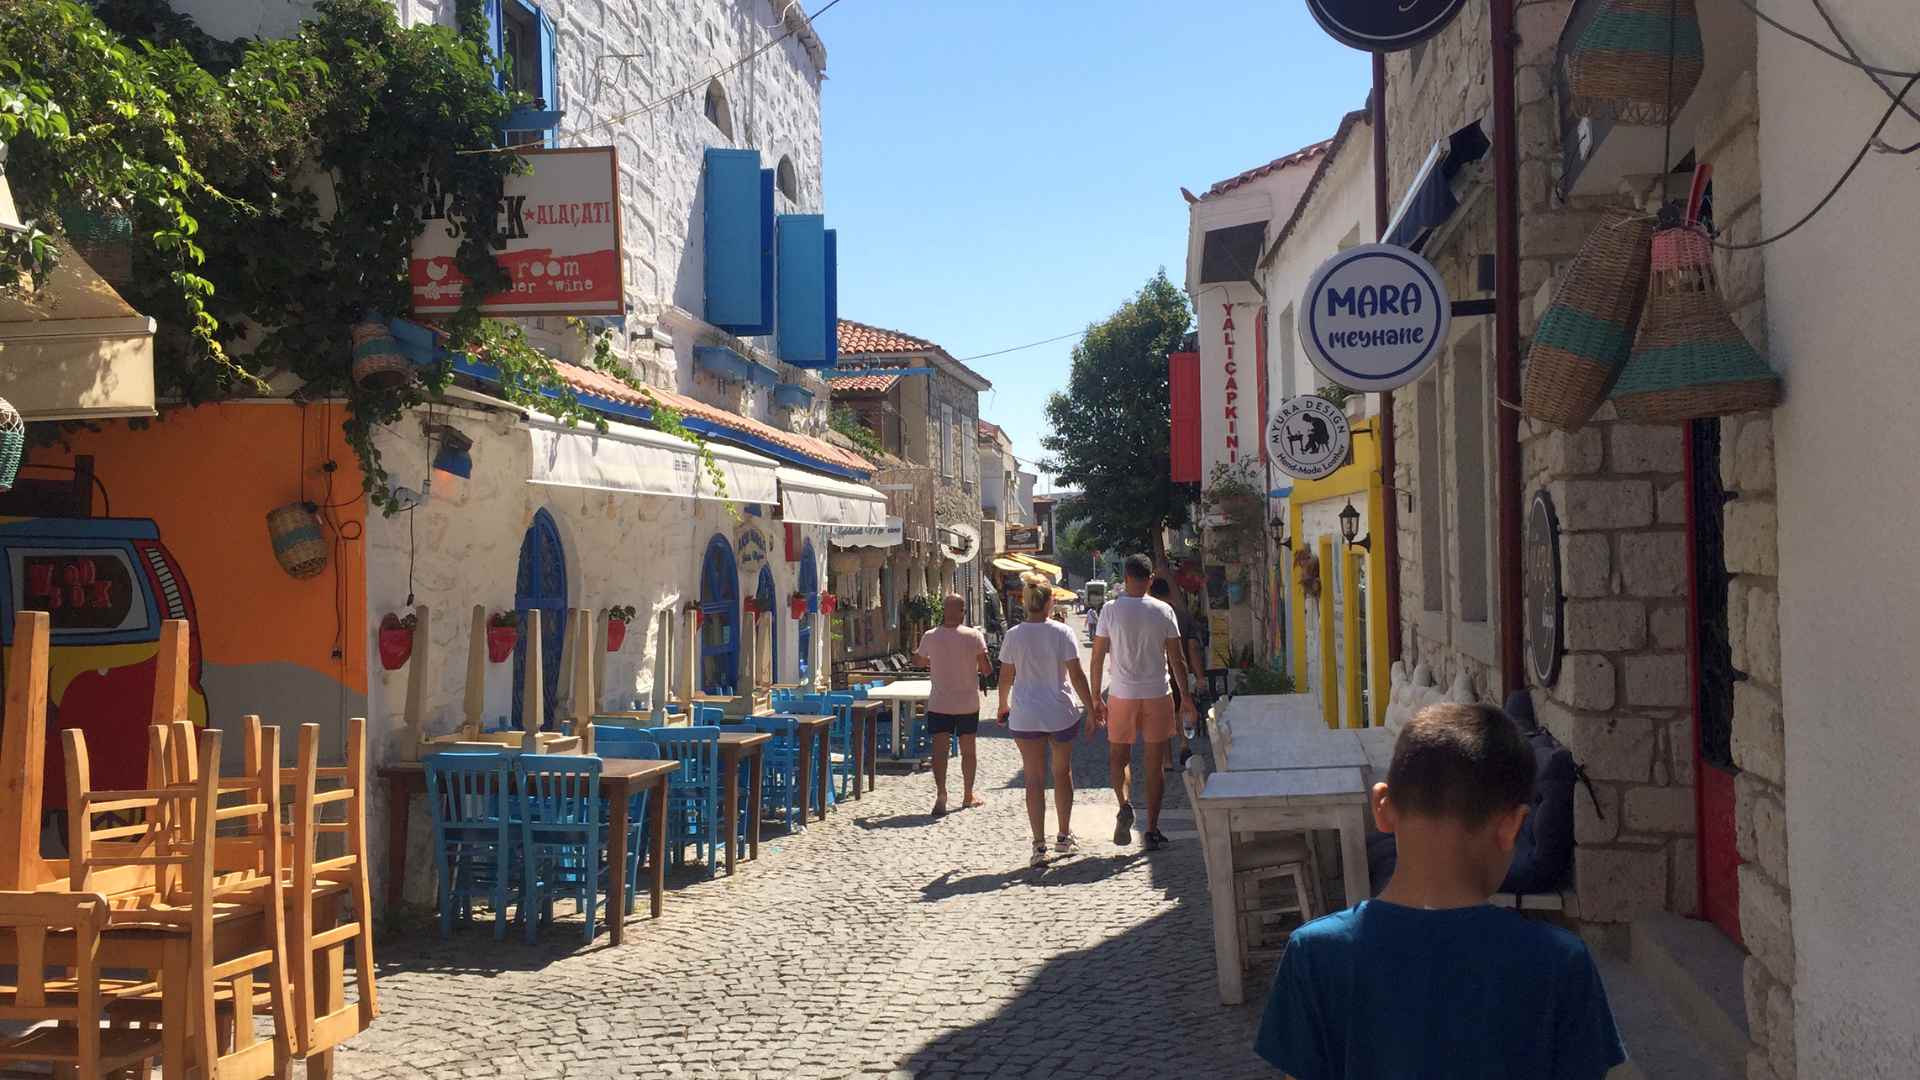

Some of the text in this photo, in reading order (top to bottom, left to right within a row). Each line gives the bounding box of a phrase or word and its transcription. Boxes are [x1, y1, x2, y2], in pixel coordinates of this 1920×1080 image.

[518, 260, 579, 278] room
[1328, 282, 1422, 318] MARA
[1272, 400, 1346, 443] MYURA DESIGN
